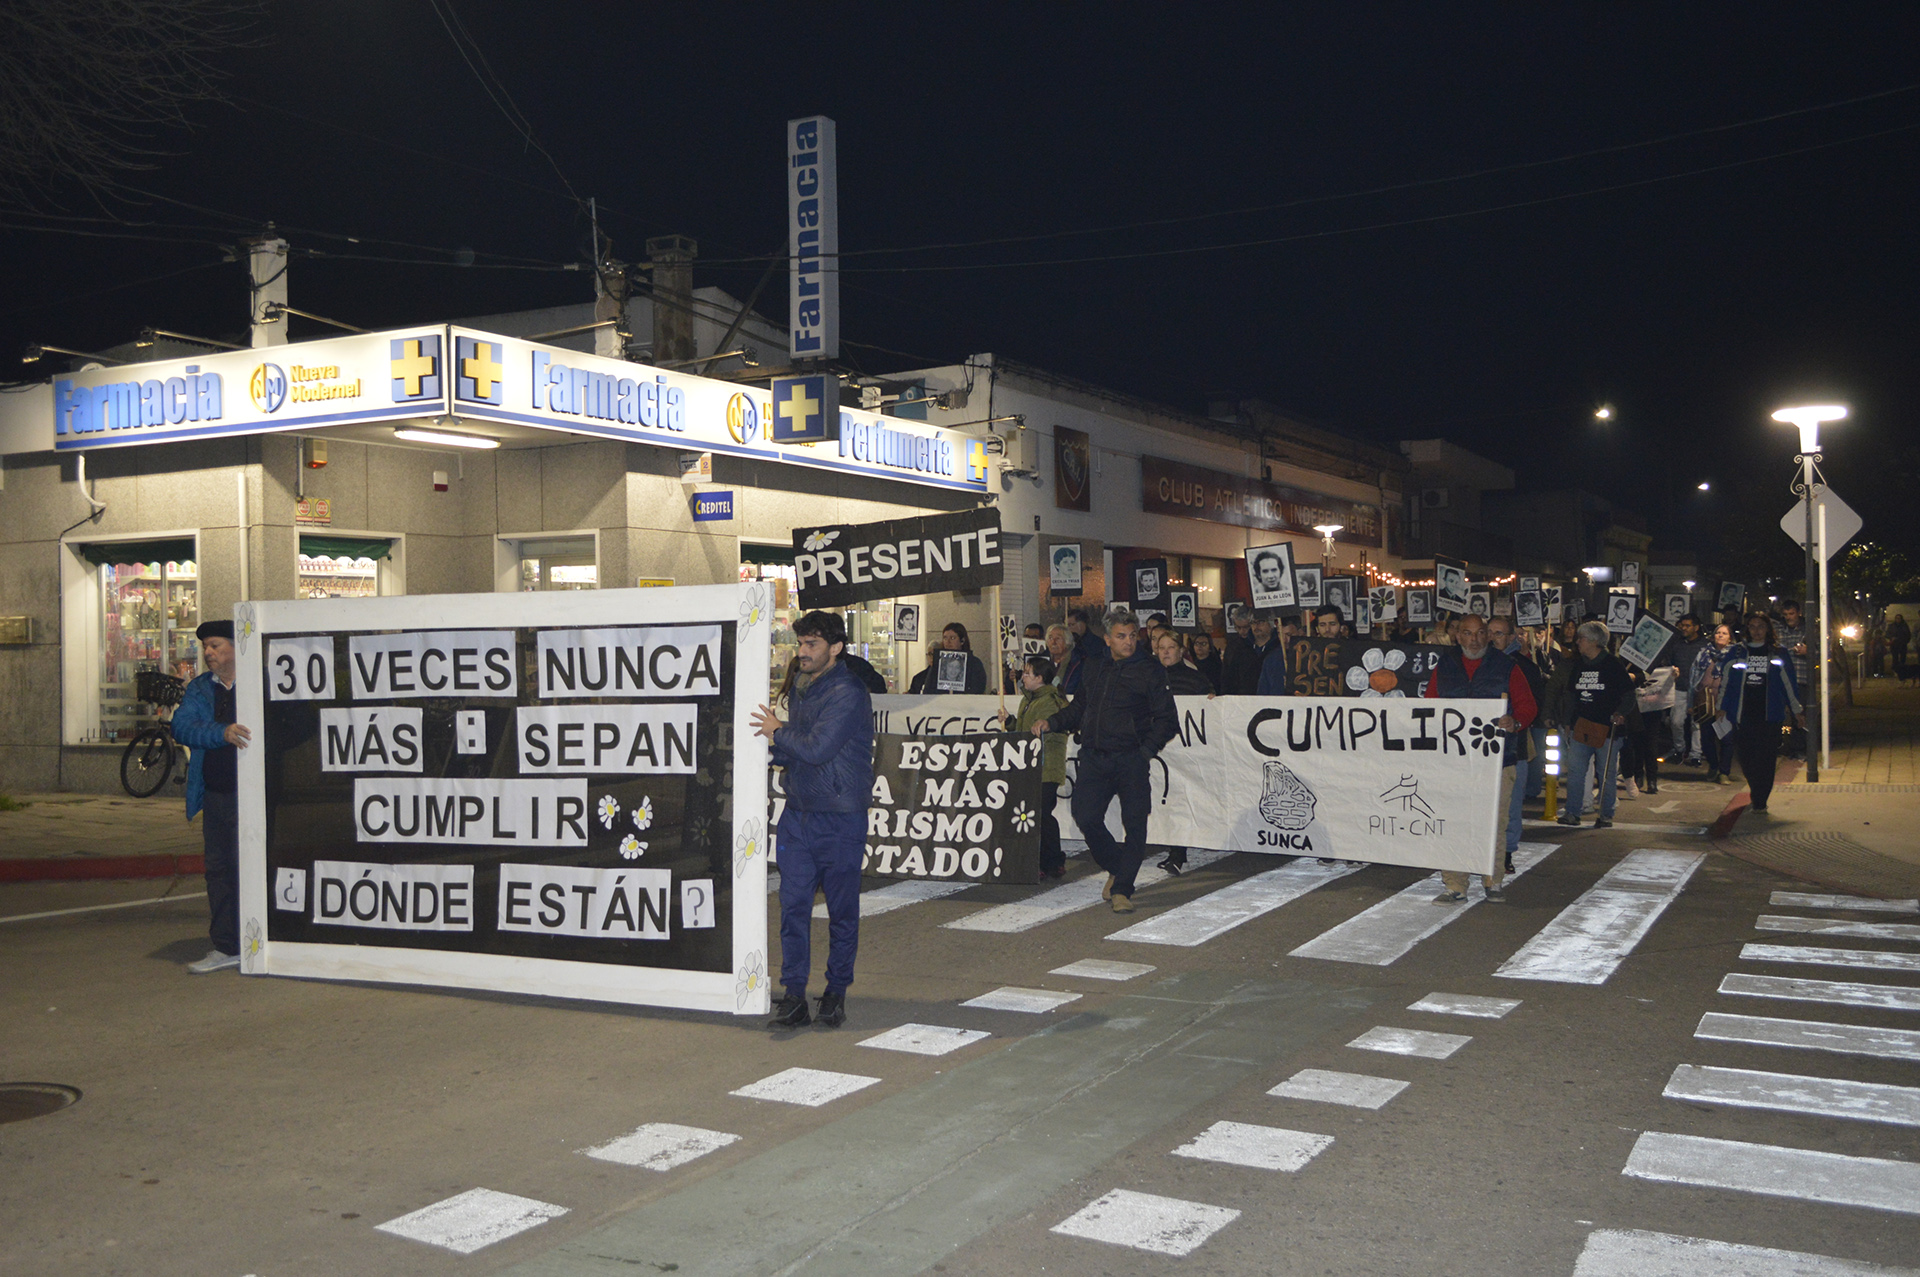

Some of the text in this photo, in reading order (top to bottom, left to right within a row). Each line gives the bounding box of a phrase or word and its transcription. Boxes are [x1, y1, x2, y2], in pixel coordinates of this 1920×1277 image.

[792, 119, 821, 353] Farmacia
[290, 364, 338, 383] Nueva
[290, 377, 362, 403] Modernel
[531, 350, 686, 433] Farmacia
[55, 365, 223, 435] Farmacia
[839, 411, 955, 477] Perfumería
[695, 499, 731, 515] CREDITEL
[1159, 477, 1205, 508] CLUB
[1214, 489, 1282, 521] ATLÉTICO
[795, 527, 1000, 590] PRESENTE
[275, 644, 718, 695] 30 VECES NUNCA
[327, 714, 418, 766] MÁS
[525, 722, 694, 768] SEPAN
[1247, 706, 1466, 756] CUMPLIR
[899, 738, 1042, 772] ESTÁN?
[921, 770, 1010, 809] MÁS
[360, 793, 586, 840] CUMPLIR
[1257, 829, 1313, 851] SUNCA
[1369, 814, 1446, 836] PIT-CNT
